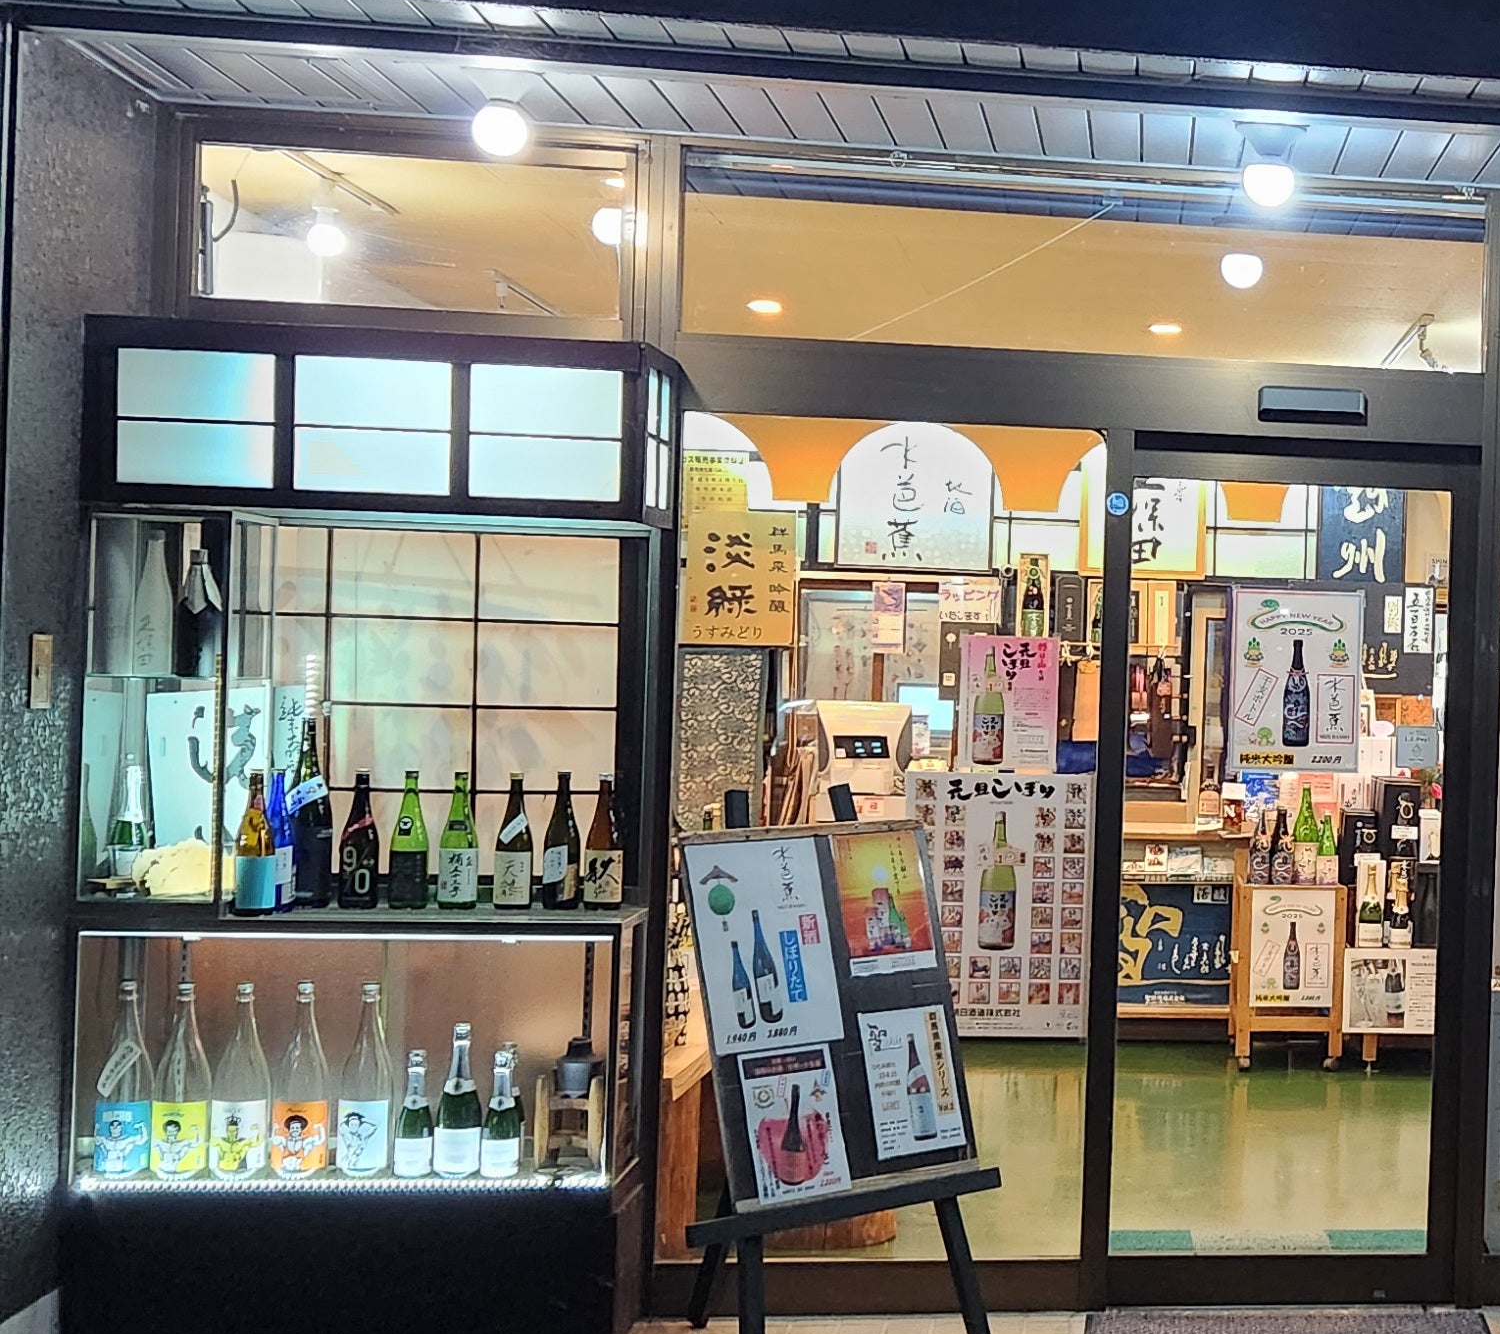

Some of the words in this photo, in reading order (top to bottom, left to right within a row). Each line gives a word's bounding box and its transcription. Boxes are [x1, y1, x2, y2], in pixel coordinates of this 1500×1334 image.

[881, 436, 922, 561] 水芭蕉
[940, 588, 999, 602] ラッピング
[1259, 613, 1286, 625] HAPPY
[1290, 612, 1311, 620] NEW
[1313, 615, 1334, 626] YEAR
[693, 626, 763, 640] うすみどり
[947, 778, 1056, 800] 元旦しぼり
[783, 931, 804, 1003] しぼりたて
